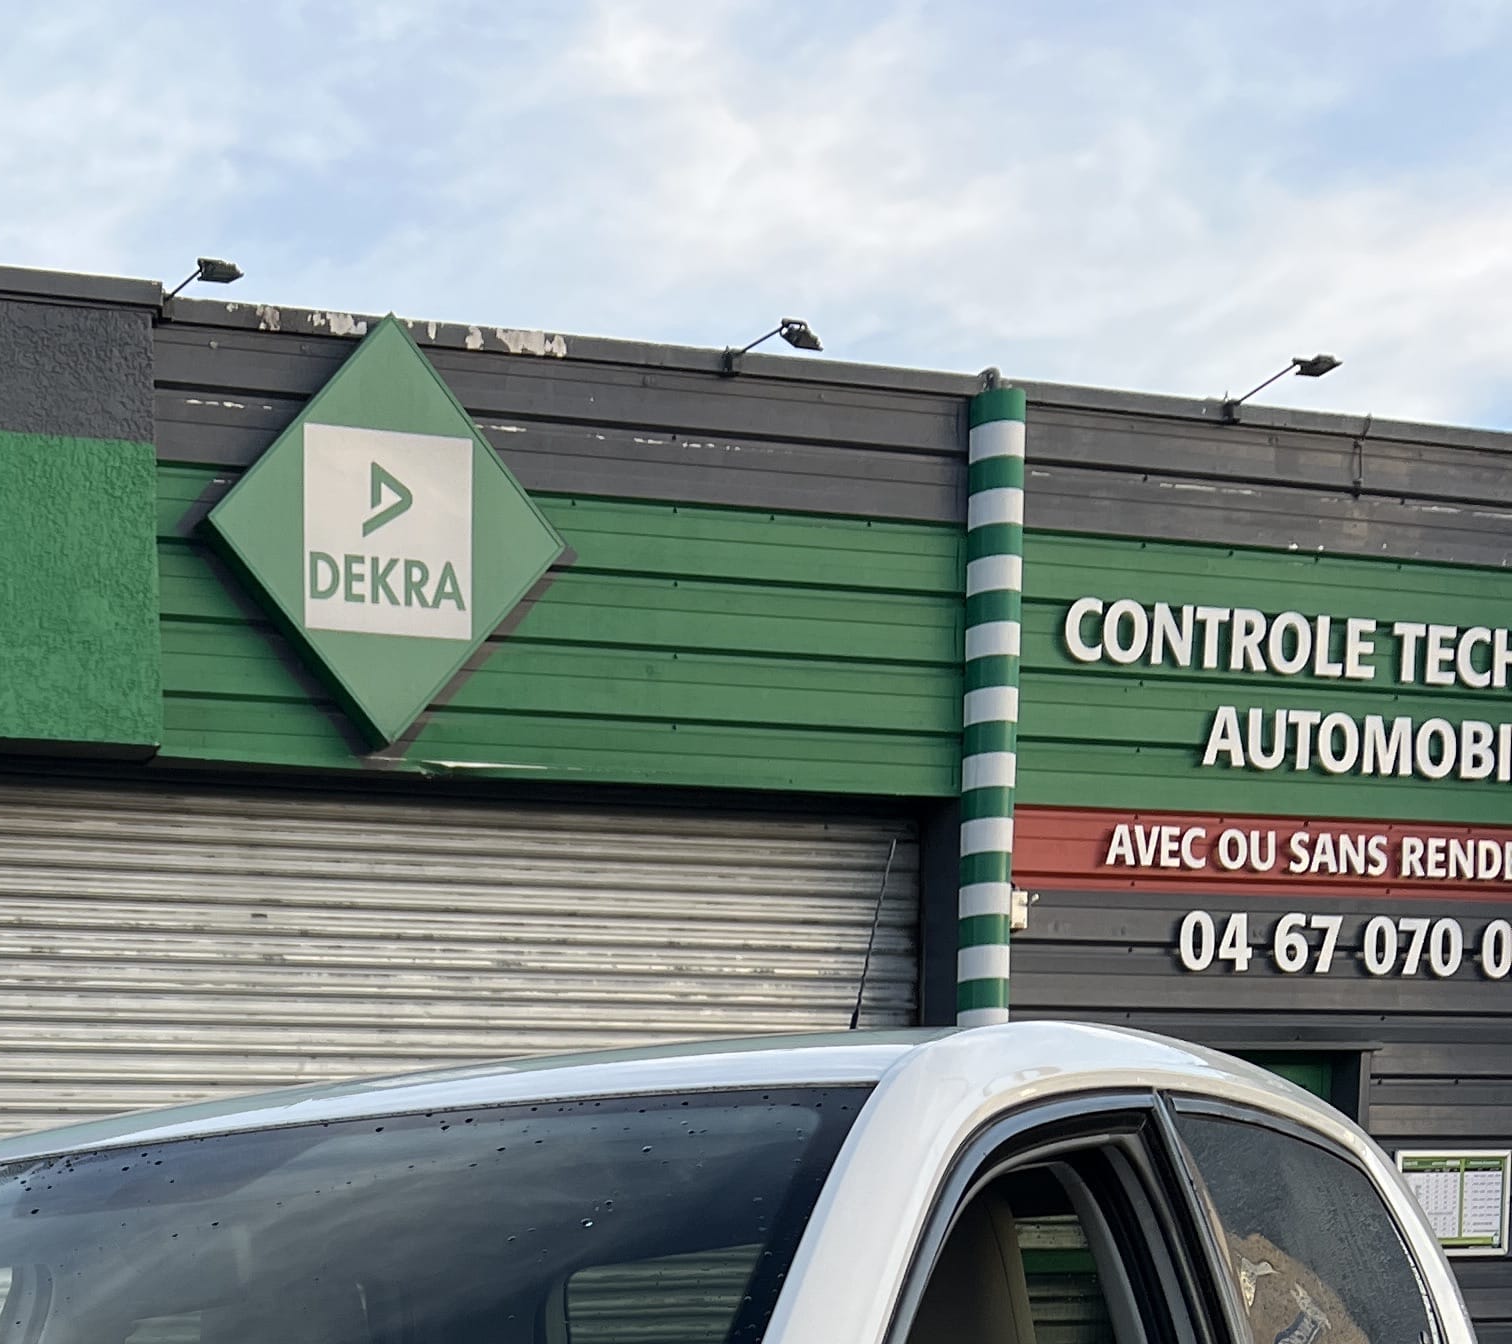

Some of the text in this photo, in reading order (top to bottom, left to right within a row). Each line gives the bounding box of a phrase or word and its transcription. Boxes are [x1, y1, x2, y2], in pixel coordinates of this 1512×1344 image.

[309, 551, 466, 612] DEKRA
[1065, 597, 1377, 679] CONTROLE
[1202, 705, 1512, 782] AUTOMOBI
[1105, 824, 1207, 869] AVEC
[1218, 828, 1276, 872] OU
[1289, 831, 1388, 876] SANS
[1179, 910, 1253, 972] 04
[1274, 913, 1343, 974] 67
[1363, 915, 1464, 978] 070
